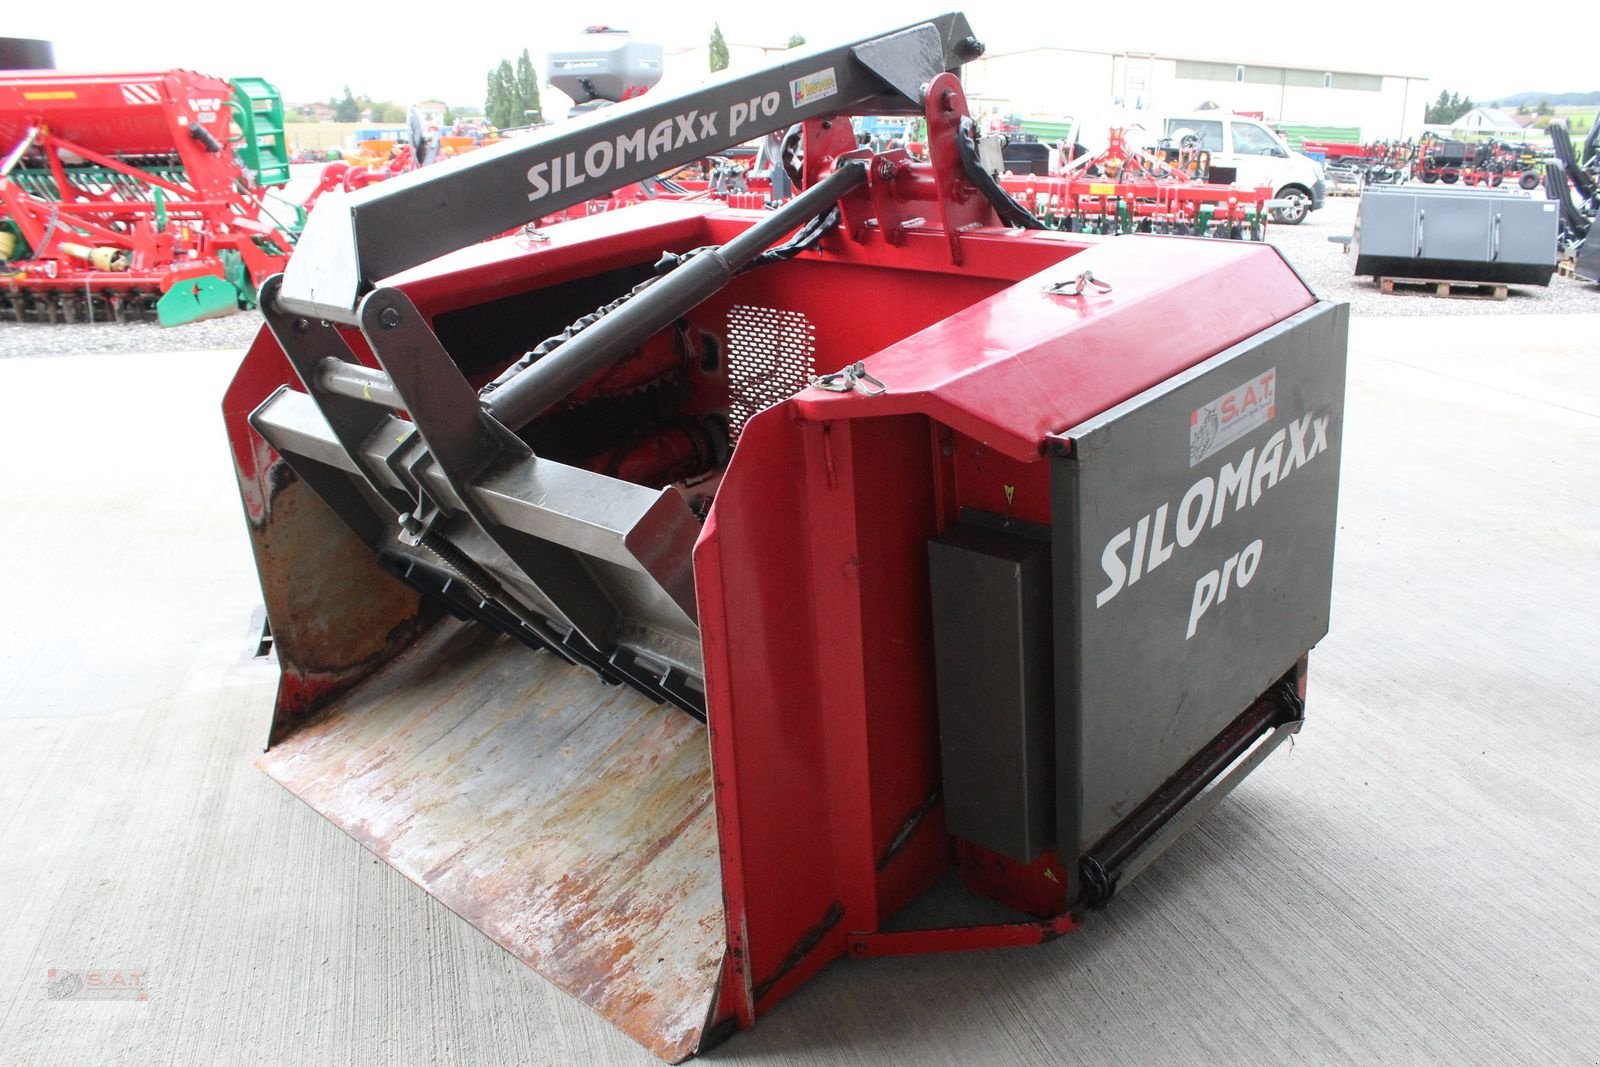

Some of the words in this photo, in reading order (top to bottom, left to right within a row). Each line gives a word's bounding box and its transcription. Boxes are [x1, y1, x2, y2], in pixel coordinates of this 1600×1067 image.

[527, 110, 718, 201] SILOMAXx
[729, 91, 780, 137] pro
[1221, 374, 1274, 423] S.A.T.
[1096, 412, 1330, 609] SILOMAXx
[1186, 539, 1263, 640] pro
